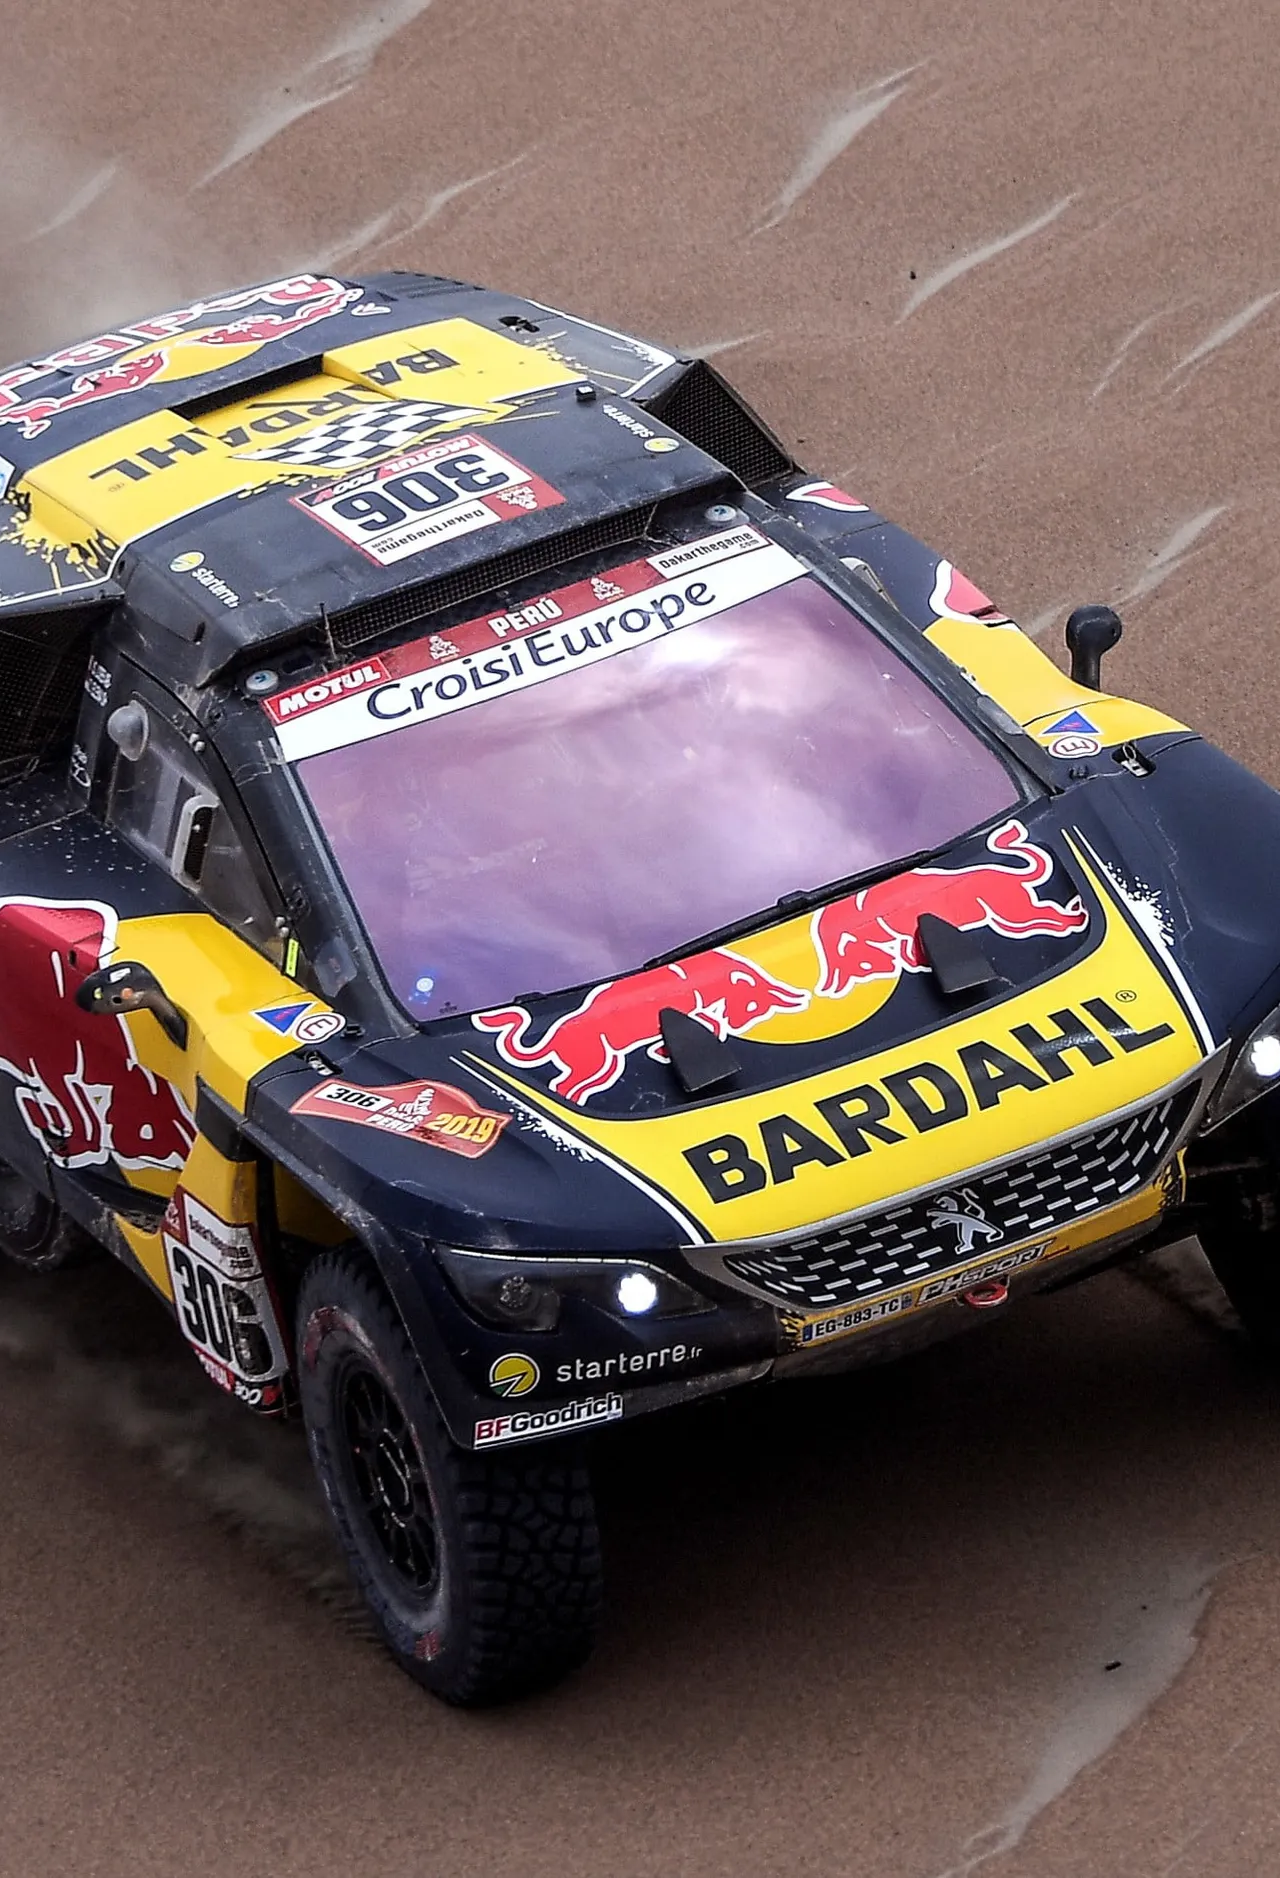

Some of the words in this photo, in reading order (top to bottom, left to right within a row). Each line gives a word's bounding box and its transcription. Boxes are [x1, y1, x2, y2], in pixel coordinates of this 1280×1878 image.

[88, 348, 461, 482] BARDAHL
[385, 437, 472, 472] MOTUL
[331, 453, 510, 532] 306
[377, 508, 486, 555] Dakarthegame
[658, 532, 753, 569] Dakarthegame
[487, 596, 564, 638] PERÚ
[278, 665, 382, 717] MOTUL
[325, 1086, 382, 1110] 306
[423, 1113, 497, 1144] 2019
[172, 1246, 274, 1377] 306
[814, 1297, 900, 1337] EG-883-TC
[475, 1391, 622, 1441] BFGoodrich
